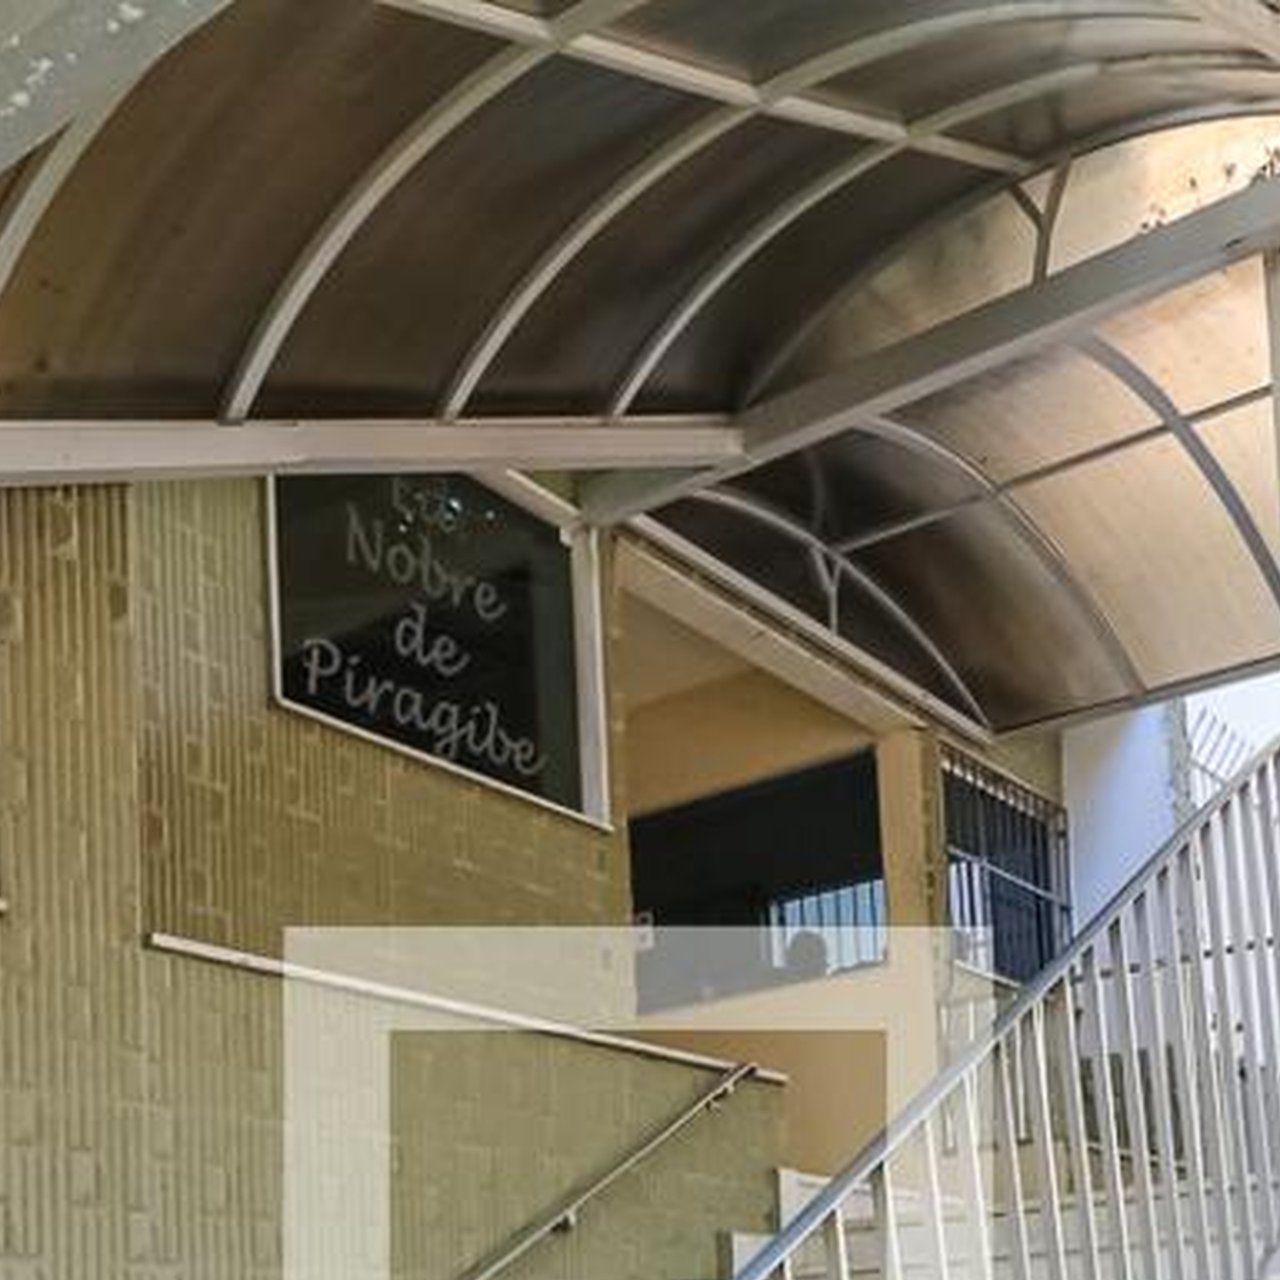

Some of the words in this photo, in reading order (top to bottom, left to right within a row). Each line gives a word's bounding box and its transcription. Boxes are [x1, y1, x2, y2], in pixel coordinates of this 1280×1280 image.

[344, 502, 508, 621] Nobre
[395, 603, 470, 676] de
[302, 639, 546, 775] Piragibe
